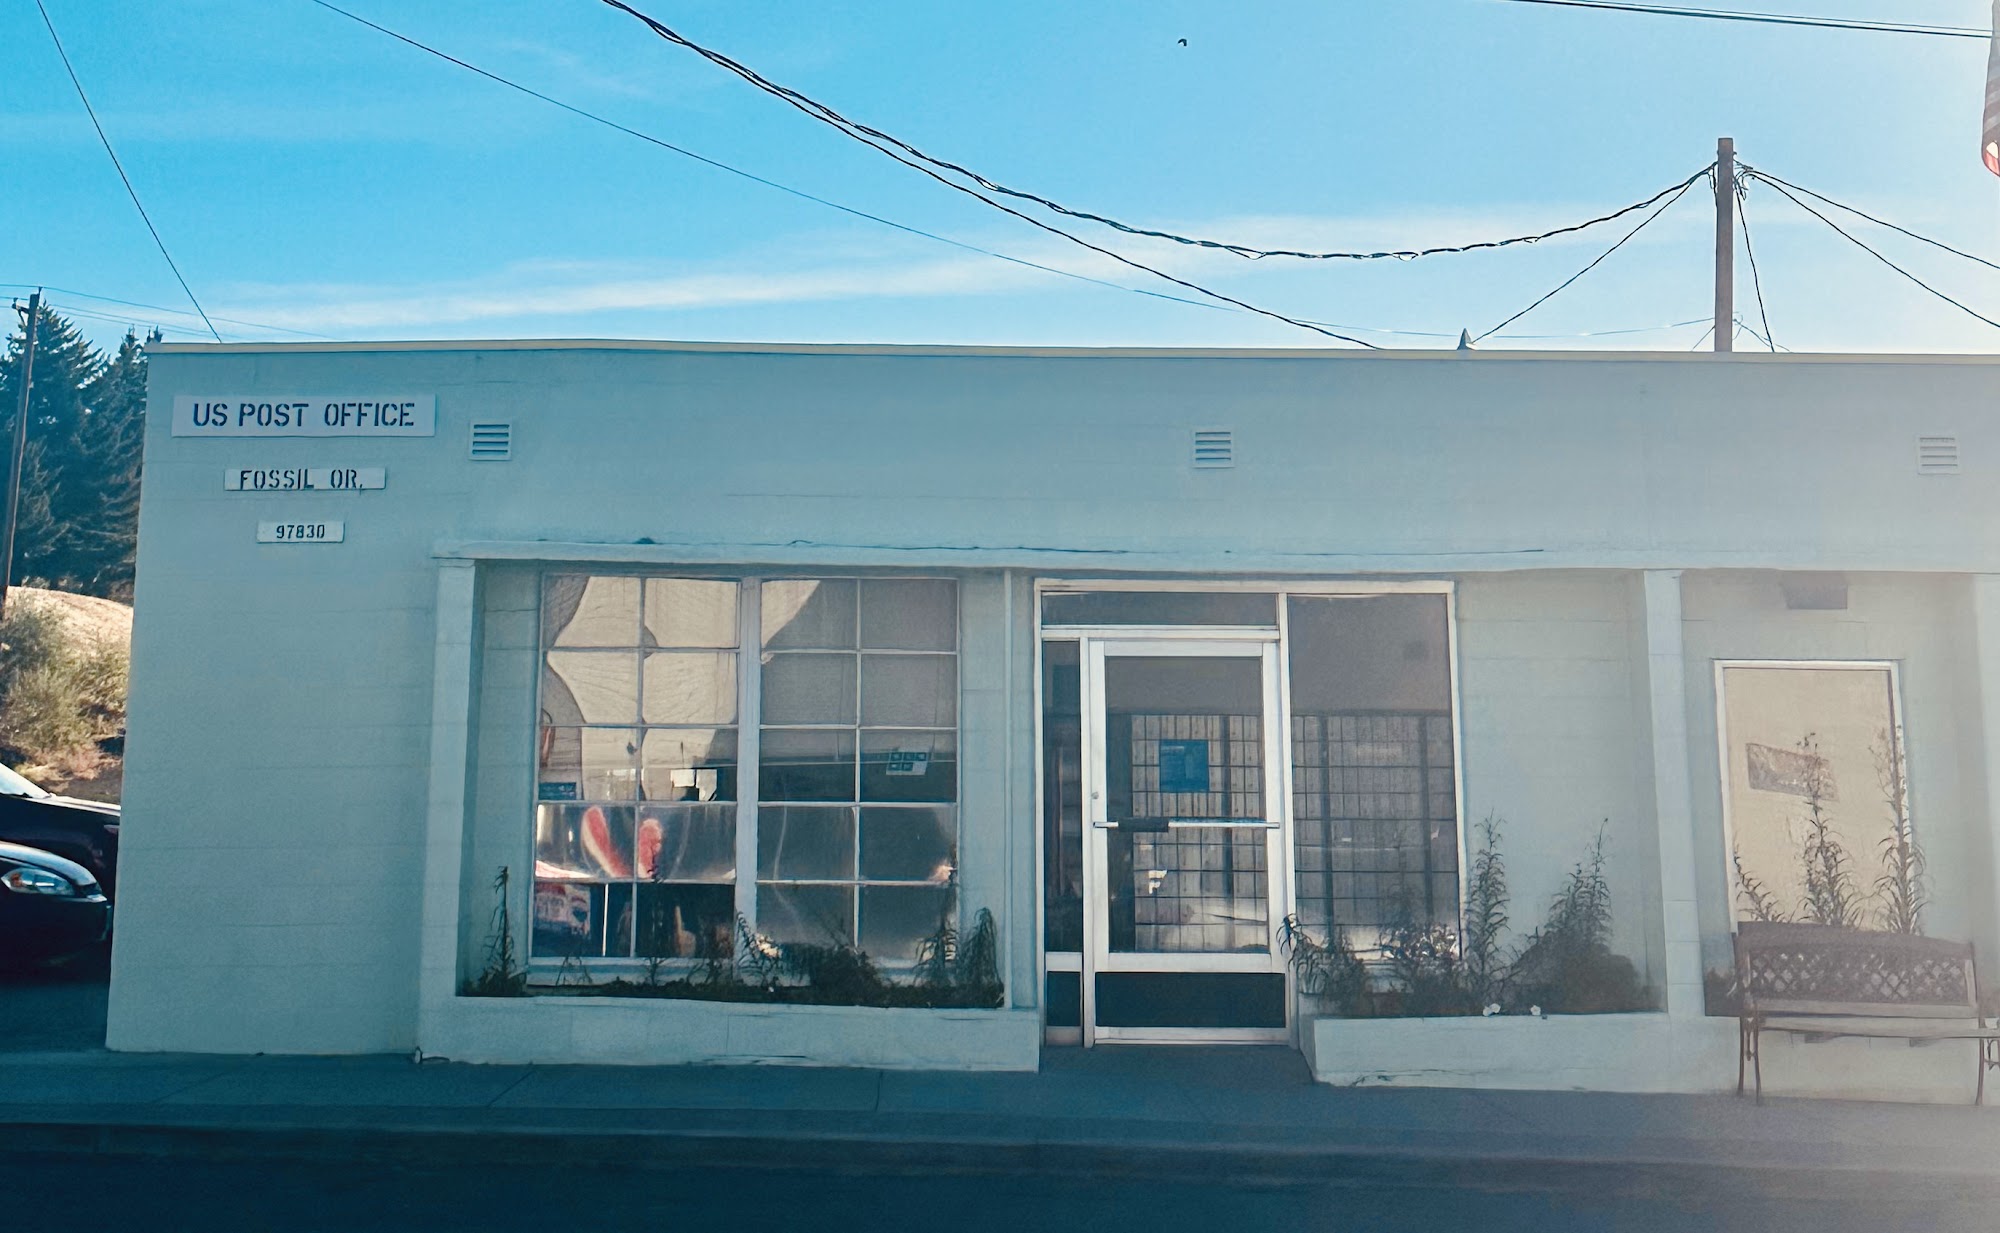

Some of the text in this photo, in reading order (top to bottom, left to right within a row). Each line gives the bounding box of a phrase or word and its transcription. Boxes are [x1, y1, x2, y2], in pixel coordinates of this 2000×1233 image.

[193, 402, 415, 427] US POST OFFICE
[240, 469, 314, 490] FOSSIL
[276, 524, 325, 540] 97830
